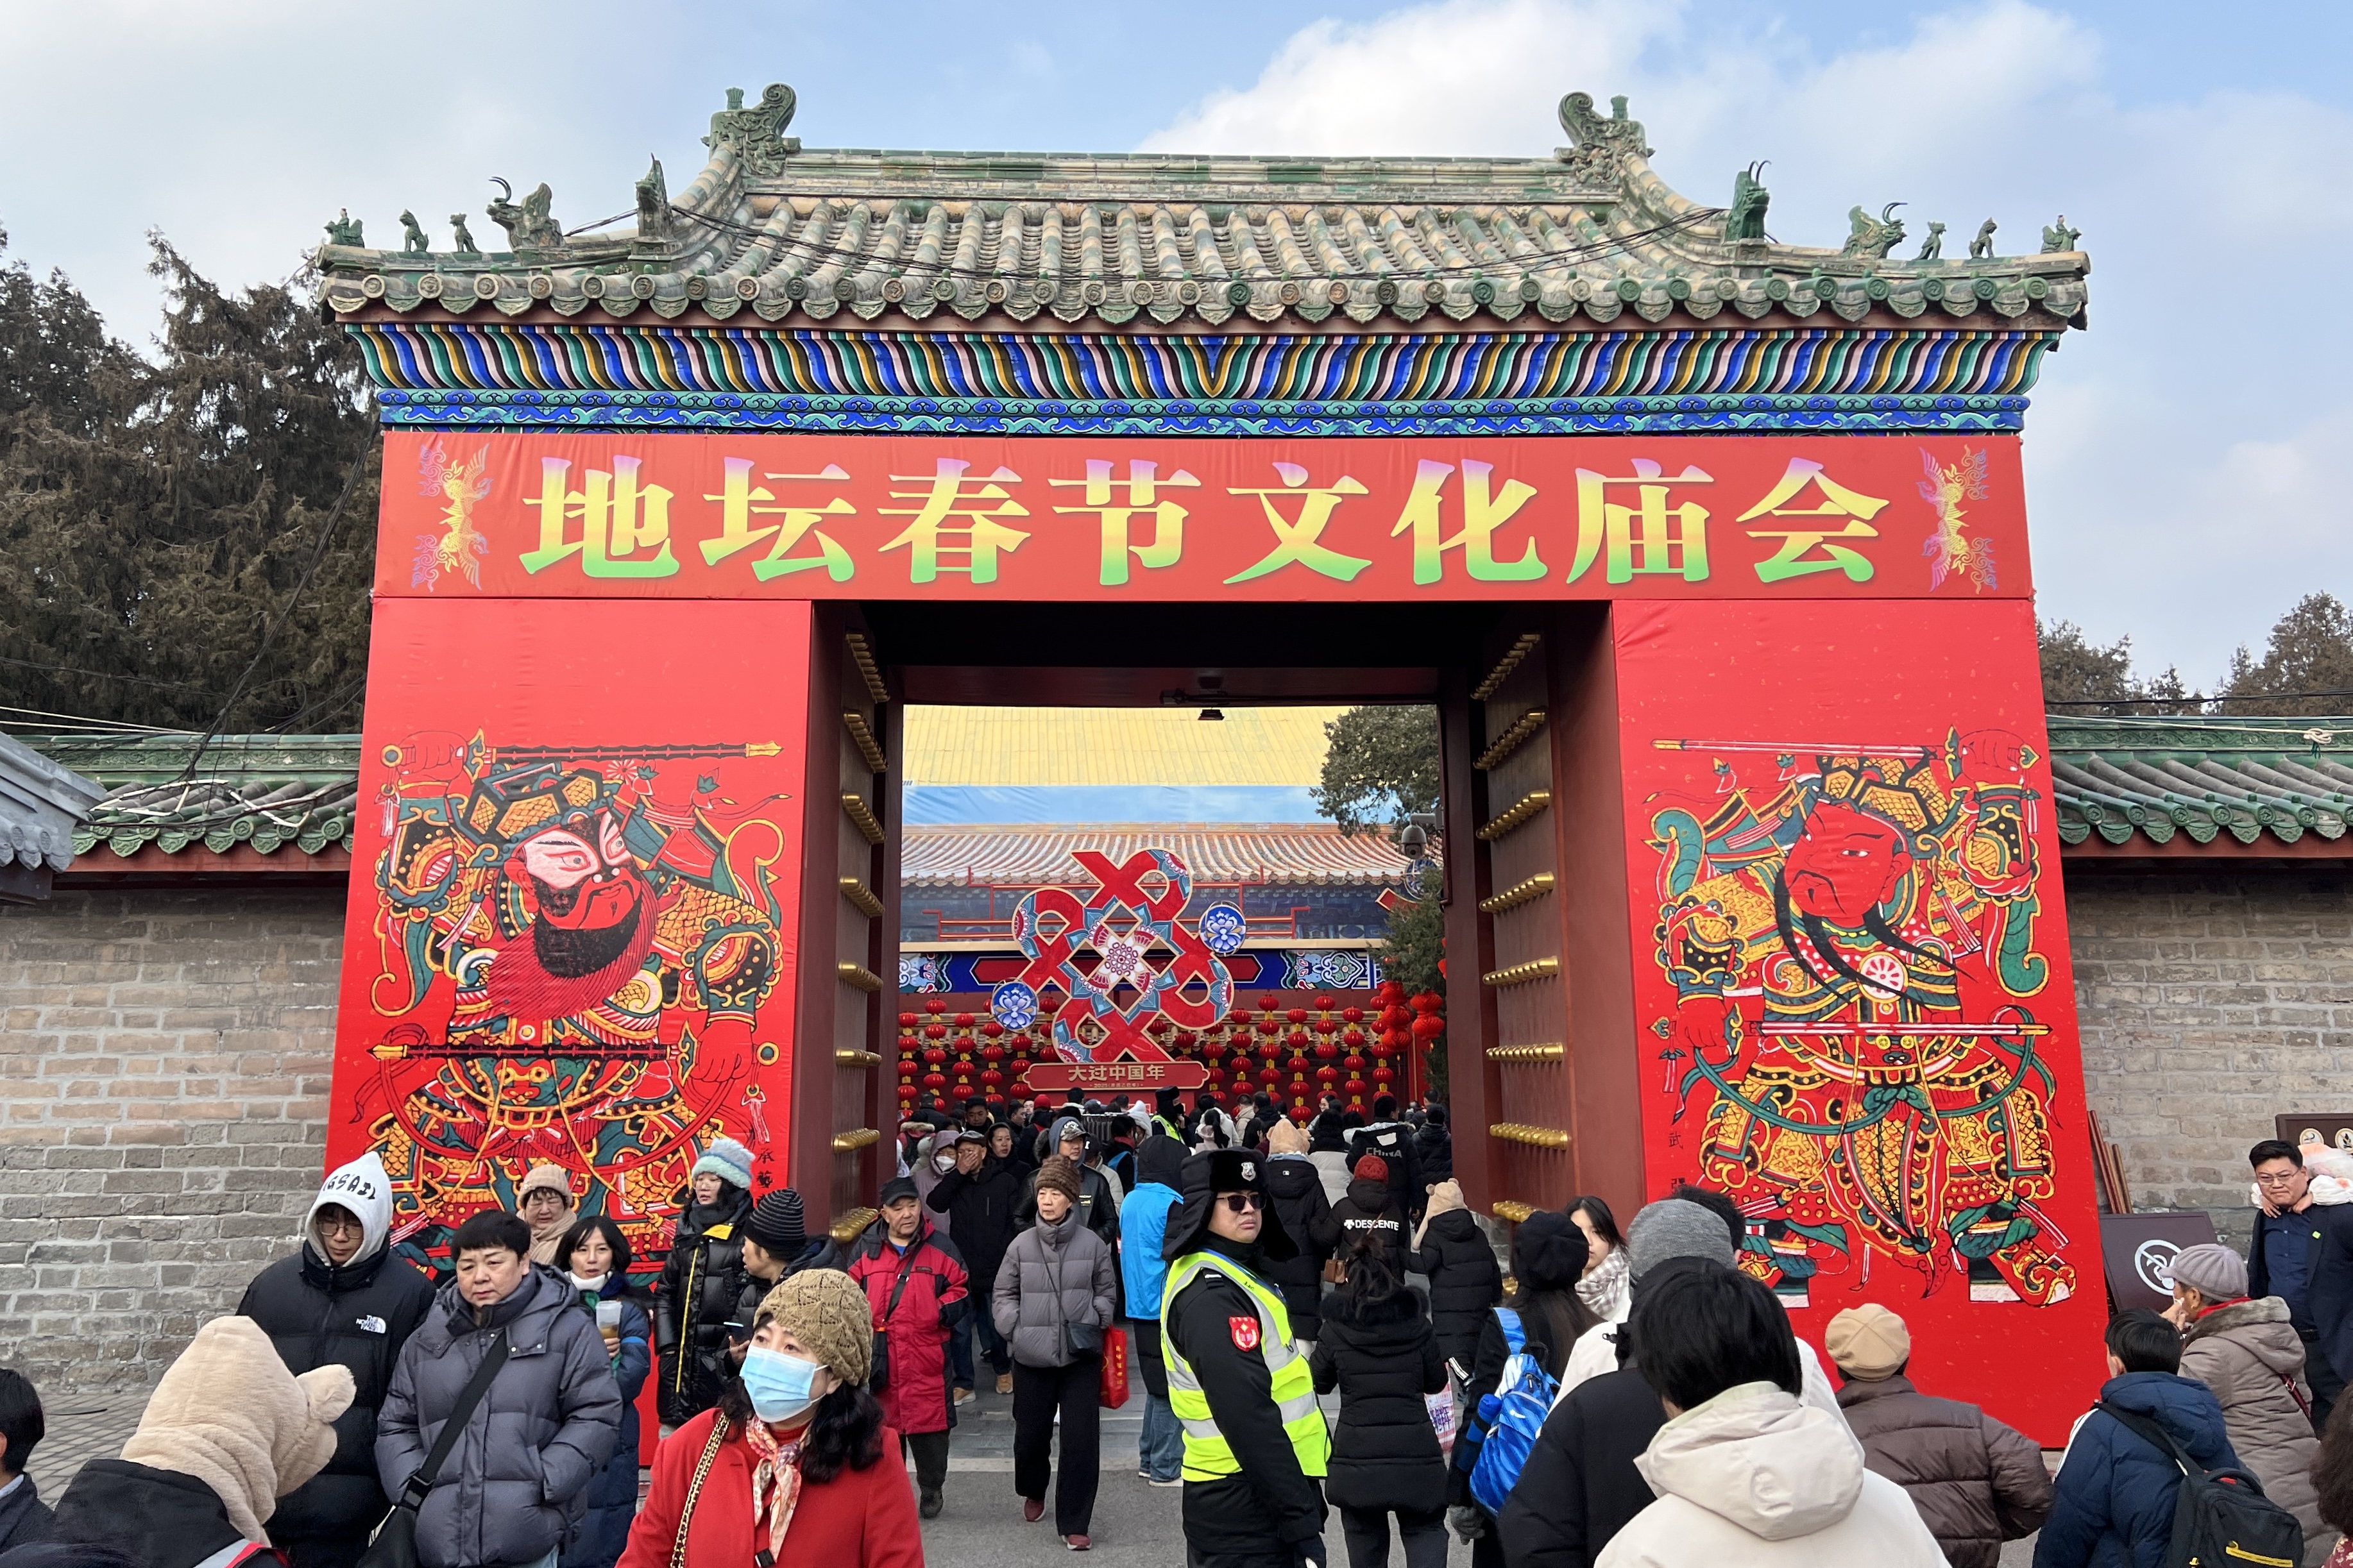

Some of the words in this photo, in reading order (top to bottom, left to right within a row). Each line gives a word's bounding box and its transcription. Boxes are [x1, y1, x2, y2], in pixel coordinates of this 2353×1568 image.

[518, 453, 1890, 586] 地坛春节文化庙会
[1067, 1064, 1166, 1082] 大过中国年
[1355, 1219, 1399, 1231] DESCENTE
